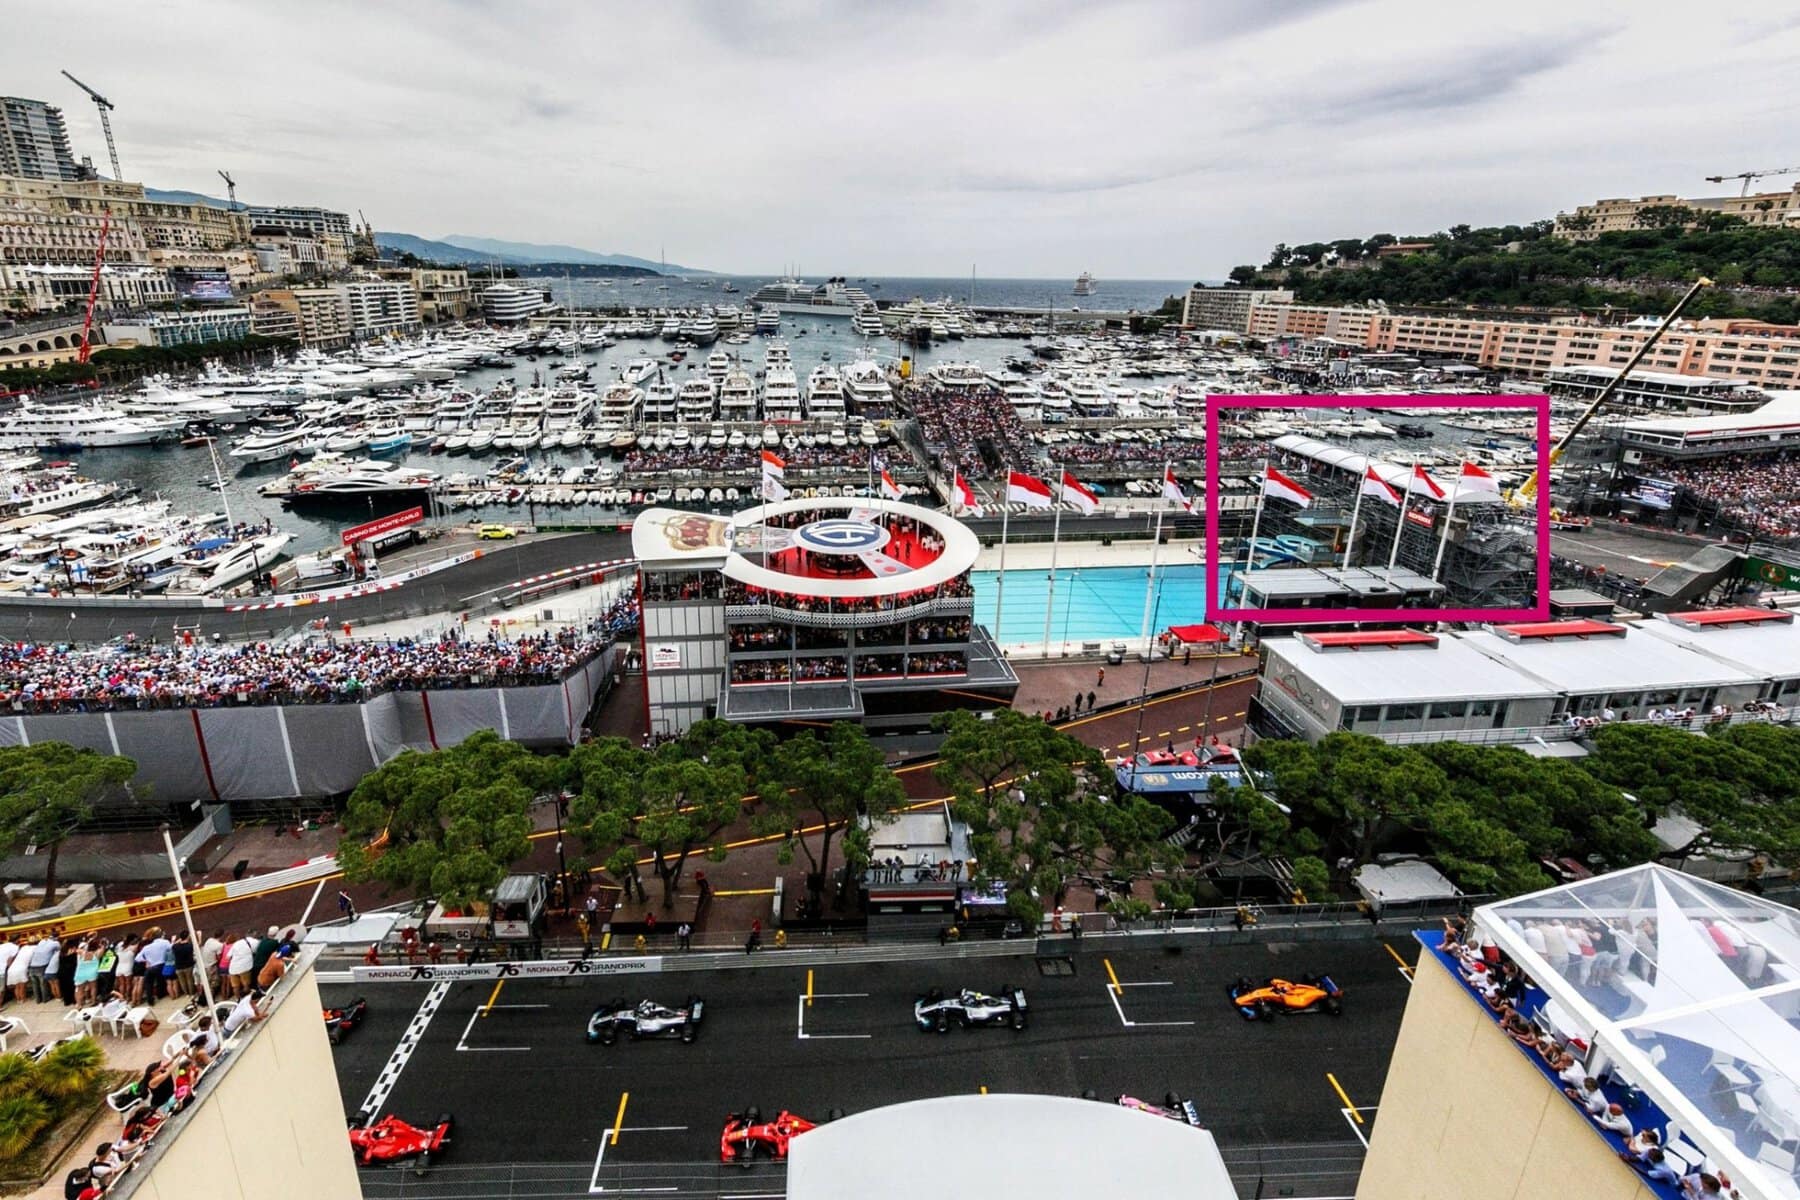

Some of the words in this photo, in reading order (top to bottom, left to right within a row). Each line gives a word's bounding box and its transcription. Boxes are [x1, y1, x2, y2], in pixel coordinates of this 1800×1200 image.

[344, 528, 369, 541] CASINO
[369, 524, 378, 533] DE
[378, 511, 420, 529] MONTE-CARLO
[460, 553, 474, 562] UBS
[415, 568, 431, 577] UBS
[360, 580, 379, 589] UBS
[301, 591, 321, 600] UBS
[457, 930, 469, 938] SC
[526, 965, 570, 974] MONACO
